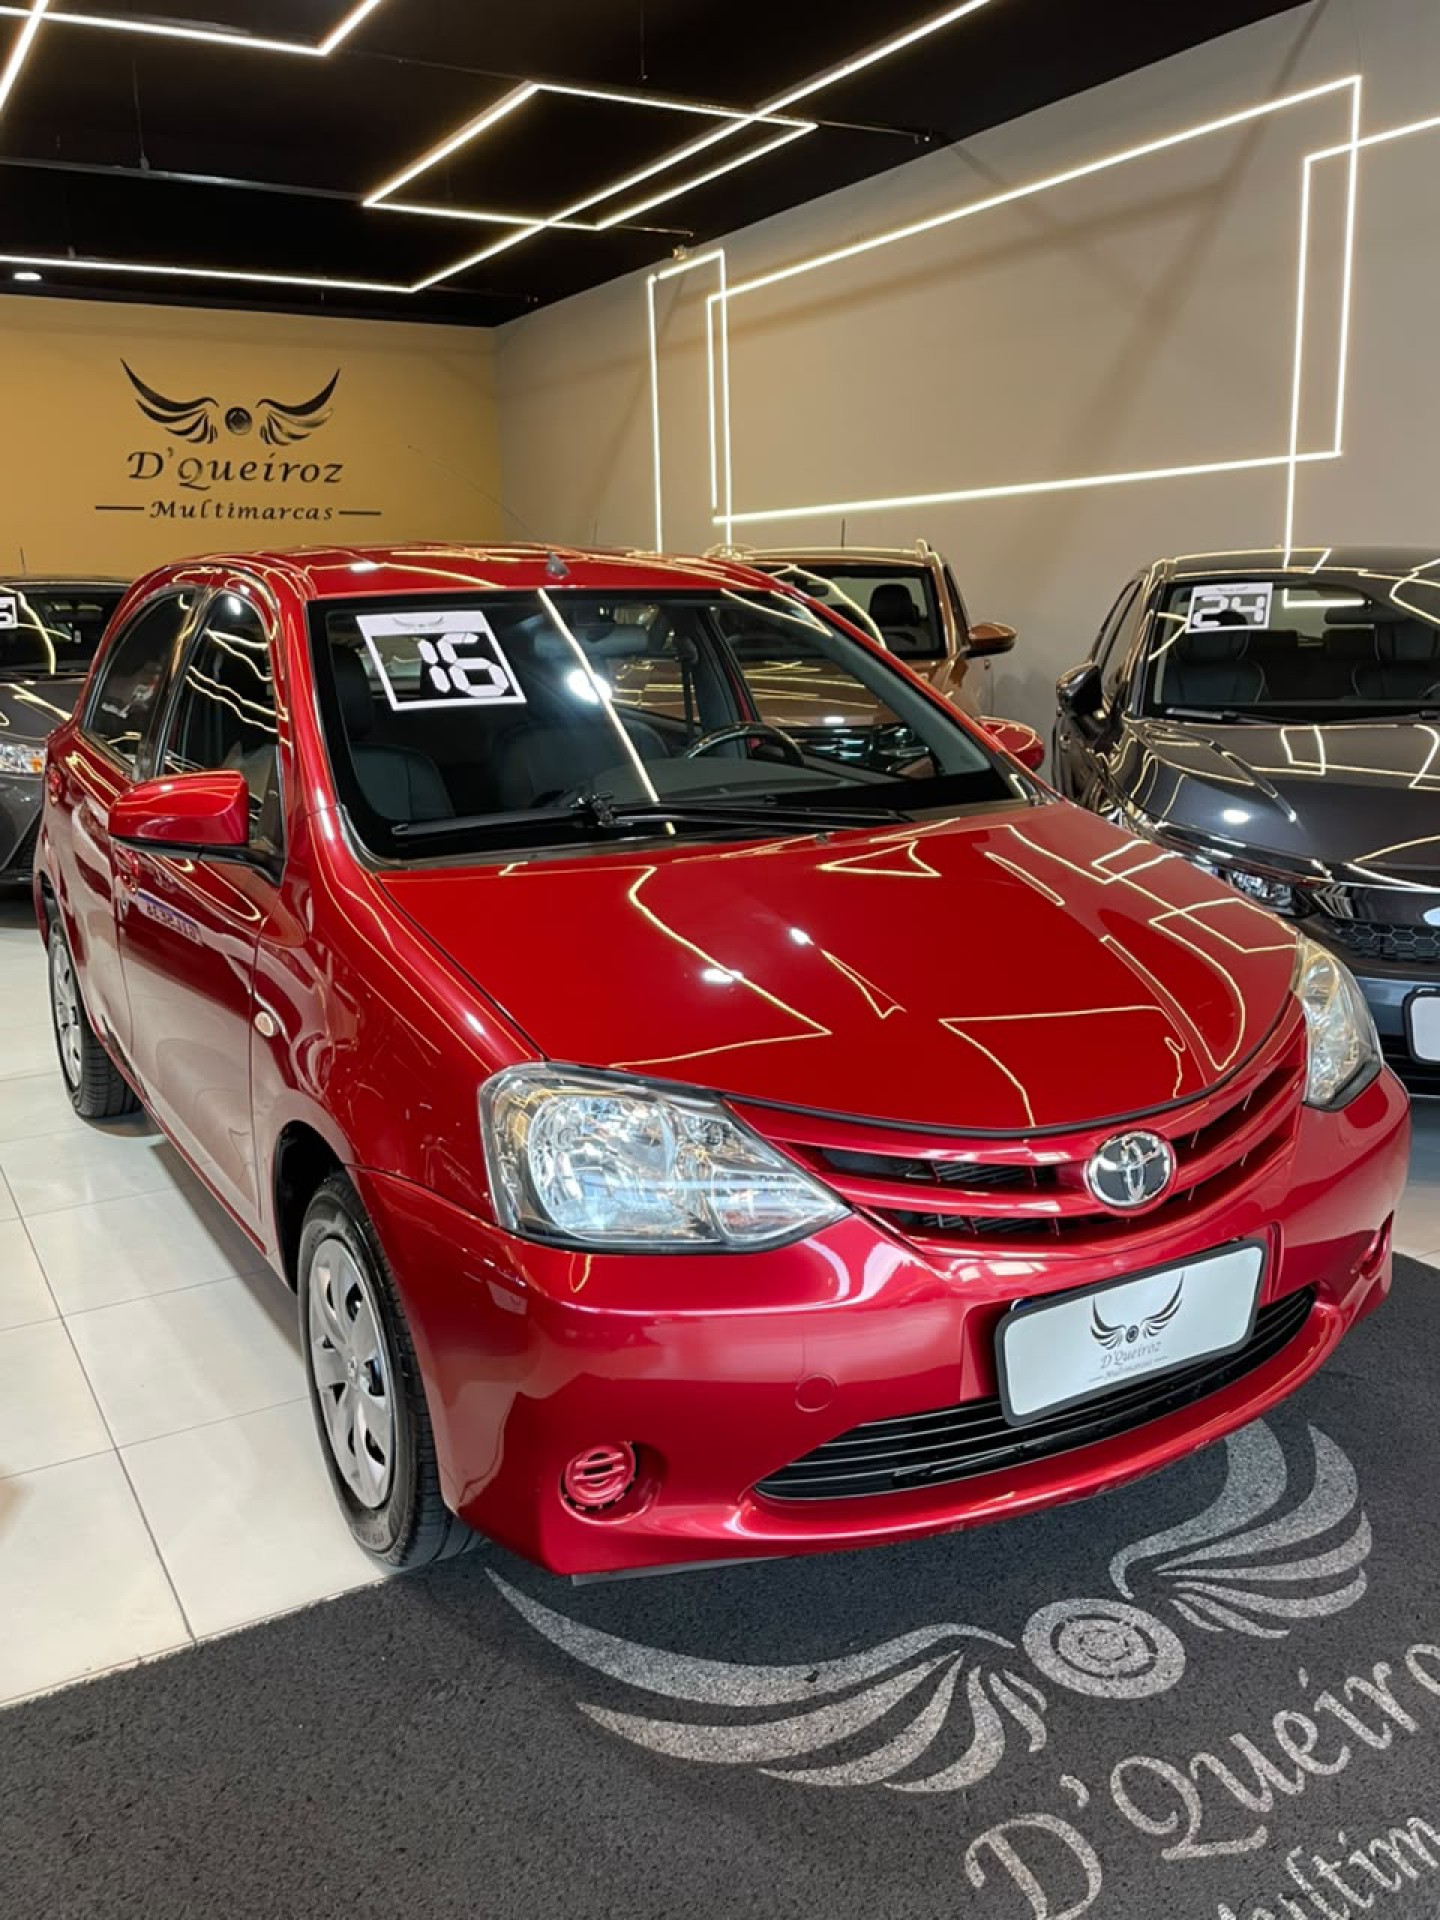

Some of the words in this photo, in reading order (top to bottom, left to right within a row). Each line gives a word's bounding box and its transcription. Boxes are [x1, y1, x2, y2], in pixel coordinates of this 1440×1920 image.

[127, 447, 344, 491] D'Queiroz
[149, 499, 334, 520] Multimarcas
[1193, 595, 1266, 627] 24
[417, 632, 510, 697] 16
